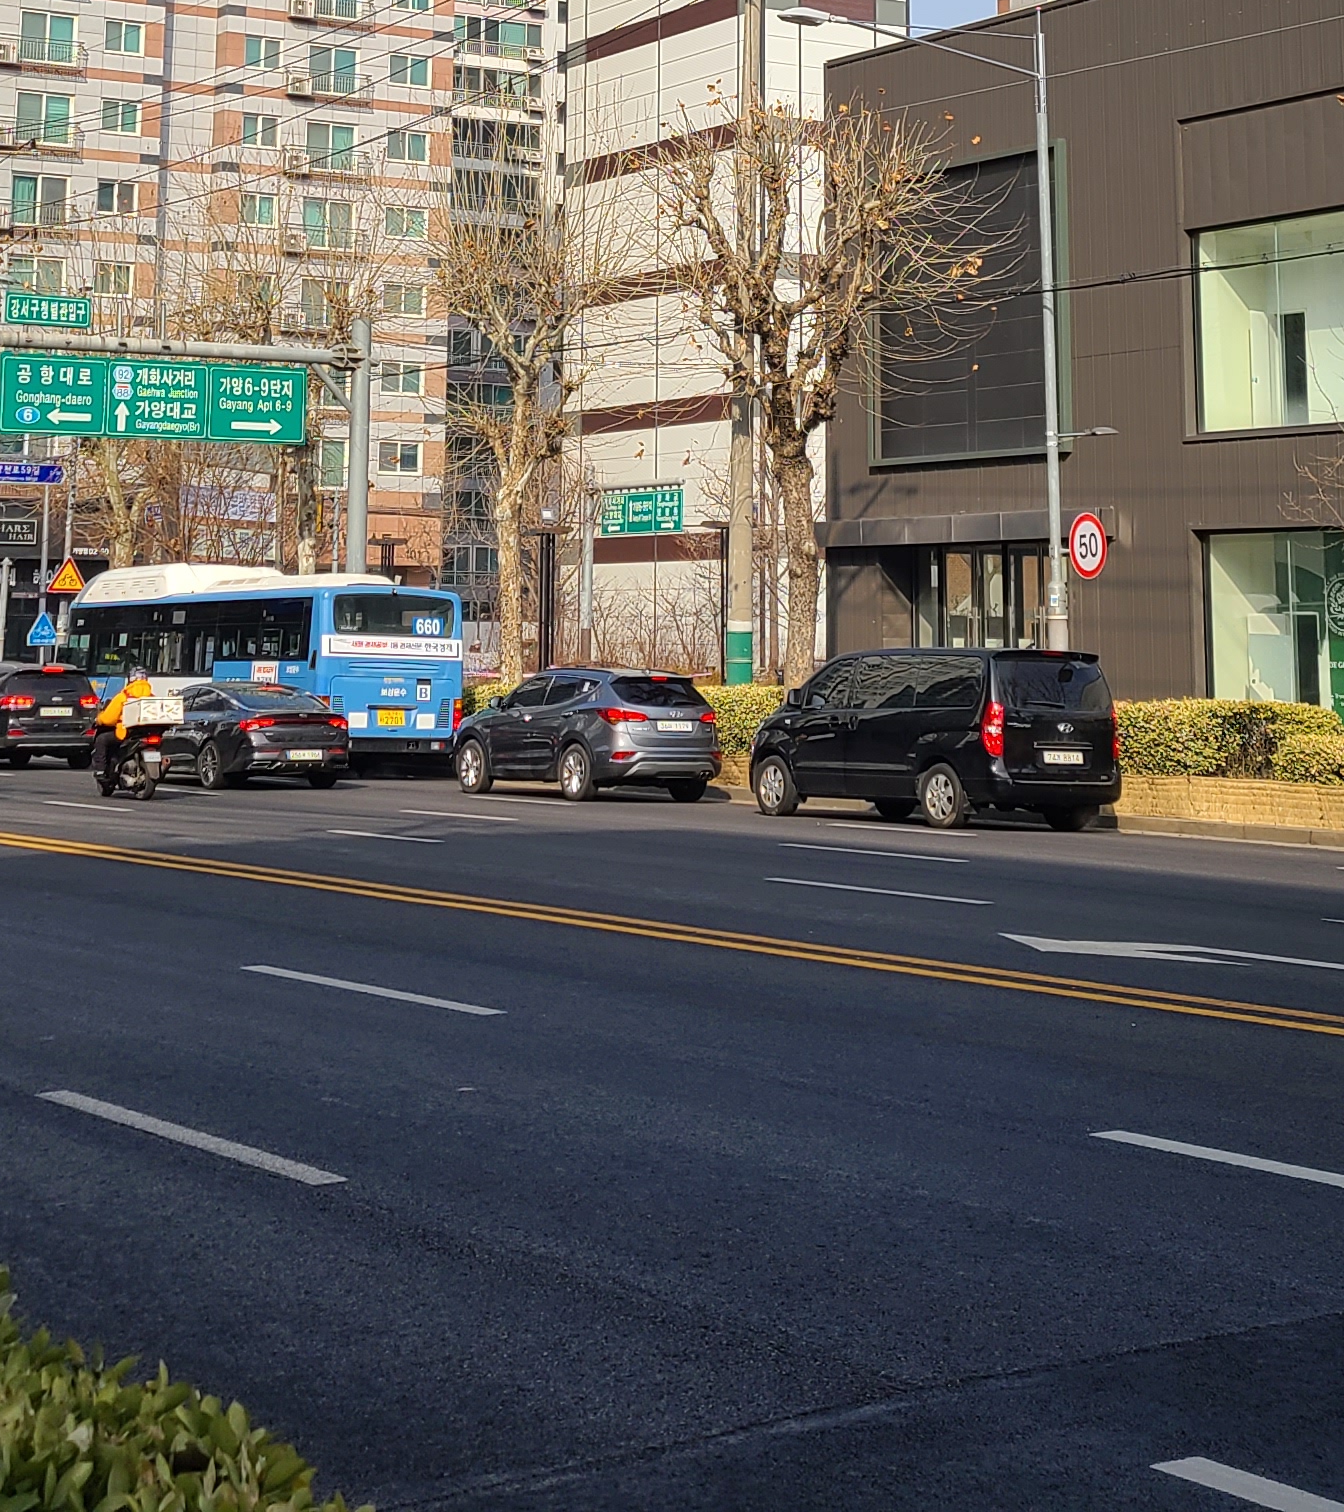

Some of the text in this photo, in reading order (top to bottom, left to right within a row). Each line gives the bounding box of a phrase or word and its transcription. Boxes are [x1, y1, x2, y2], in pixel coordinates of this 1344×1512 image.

[10, 298, 86, 322] 강서구청별관입구
[118, 369, 130, 380] 92
[135, 368, 195, 388] 개화사거리
[116, 388, 129, 398] 88
[136, 386, 199, 399] Gaehwa Junction
[219, 377, 293, 398] 가양6-9단지
[15, 390, 92, 407] Gonghang-daero
[219, 397, 254, 413] Gayang
[275, 400, 293, 412] 6-9
[23, 408, 33, 421] 6
[135, 401, 197, 419] 가양대교
[8, 532, 34, 541] HAIR
[1079, 532, 1099, 559] 50
[416, 619, 440, 635] 660
[419, 687, 429, 699] B
